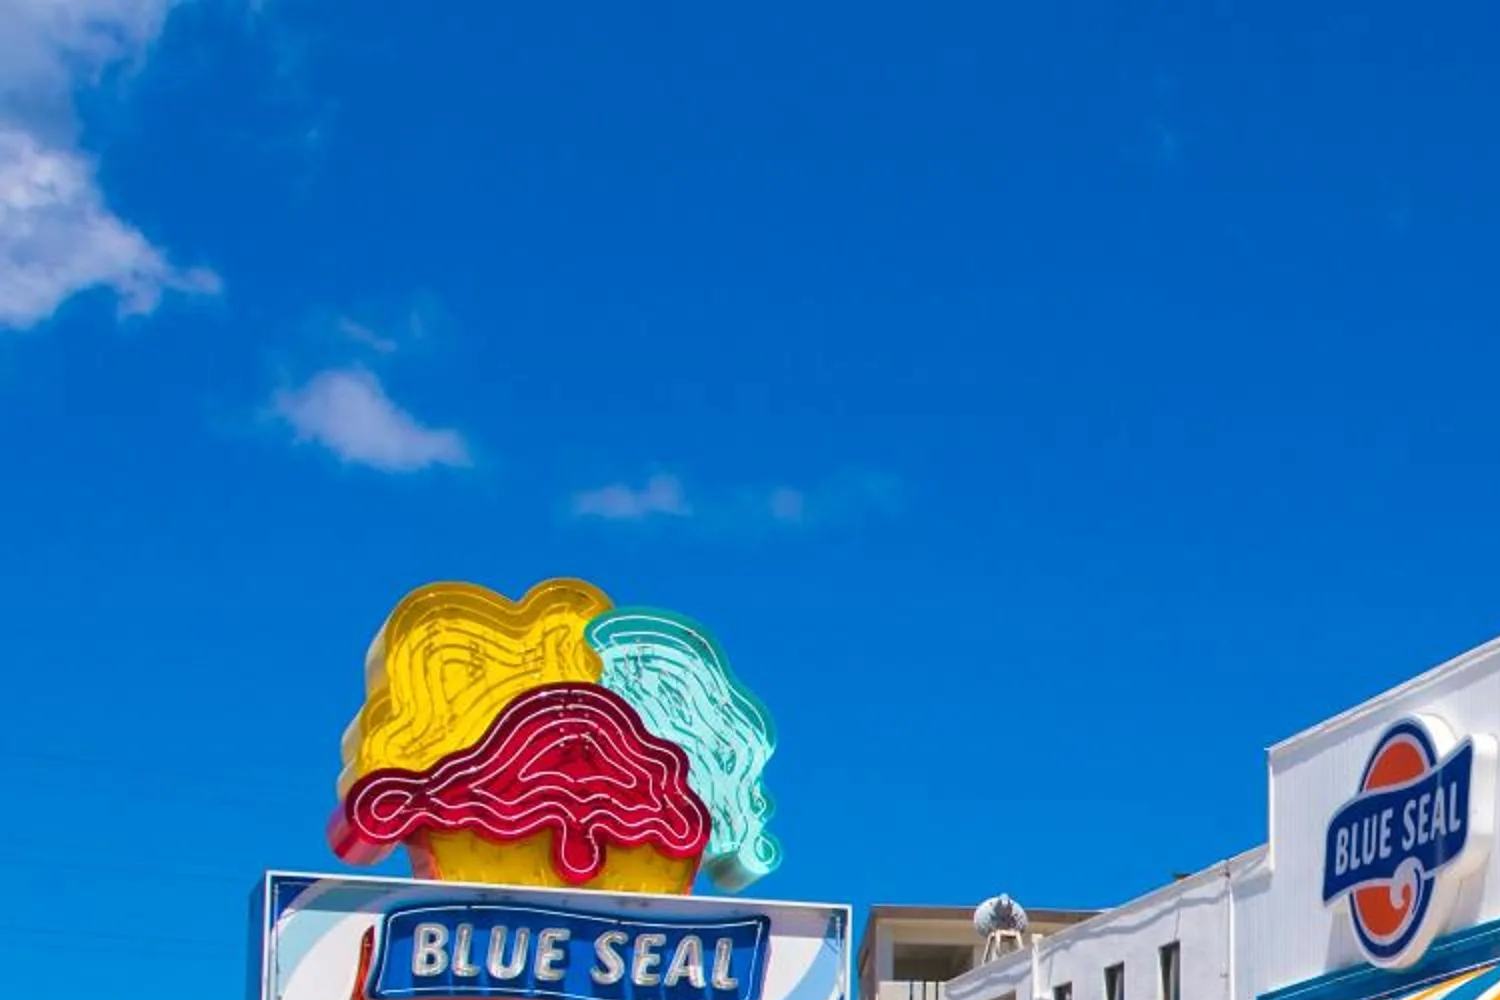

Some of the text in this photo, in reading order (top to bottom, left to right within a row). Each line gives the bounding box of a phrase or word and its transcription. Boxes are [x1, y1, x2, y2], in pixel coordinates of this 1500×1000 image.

[1335, 781, 1461, 876] BLUE SEAL
[411, 922, 739, 990] BLUE SEAL
